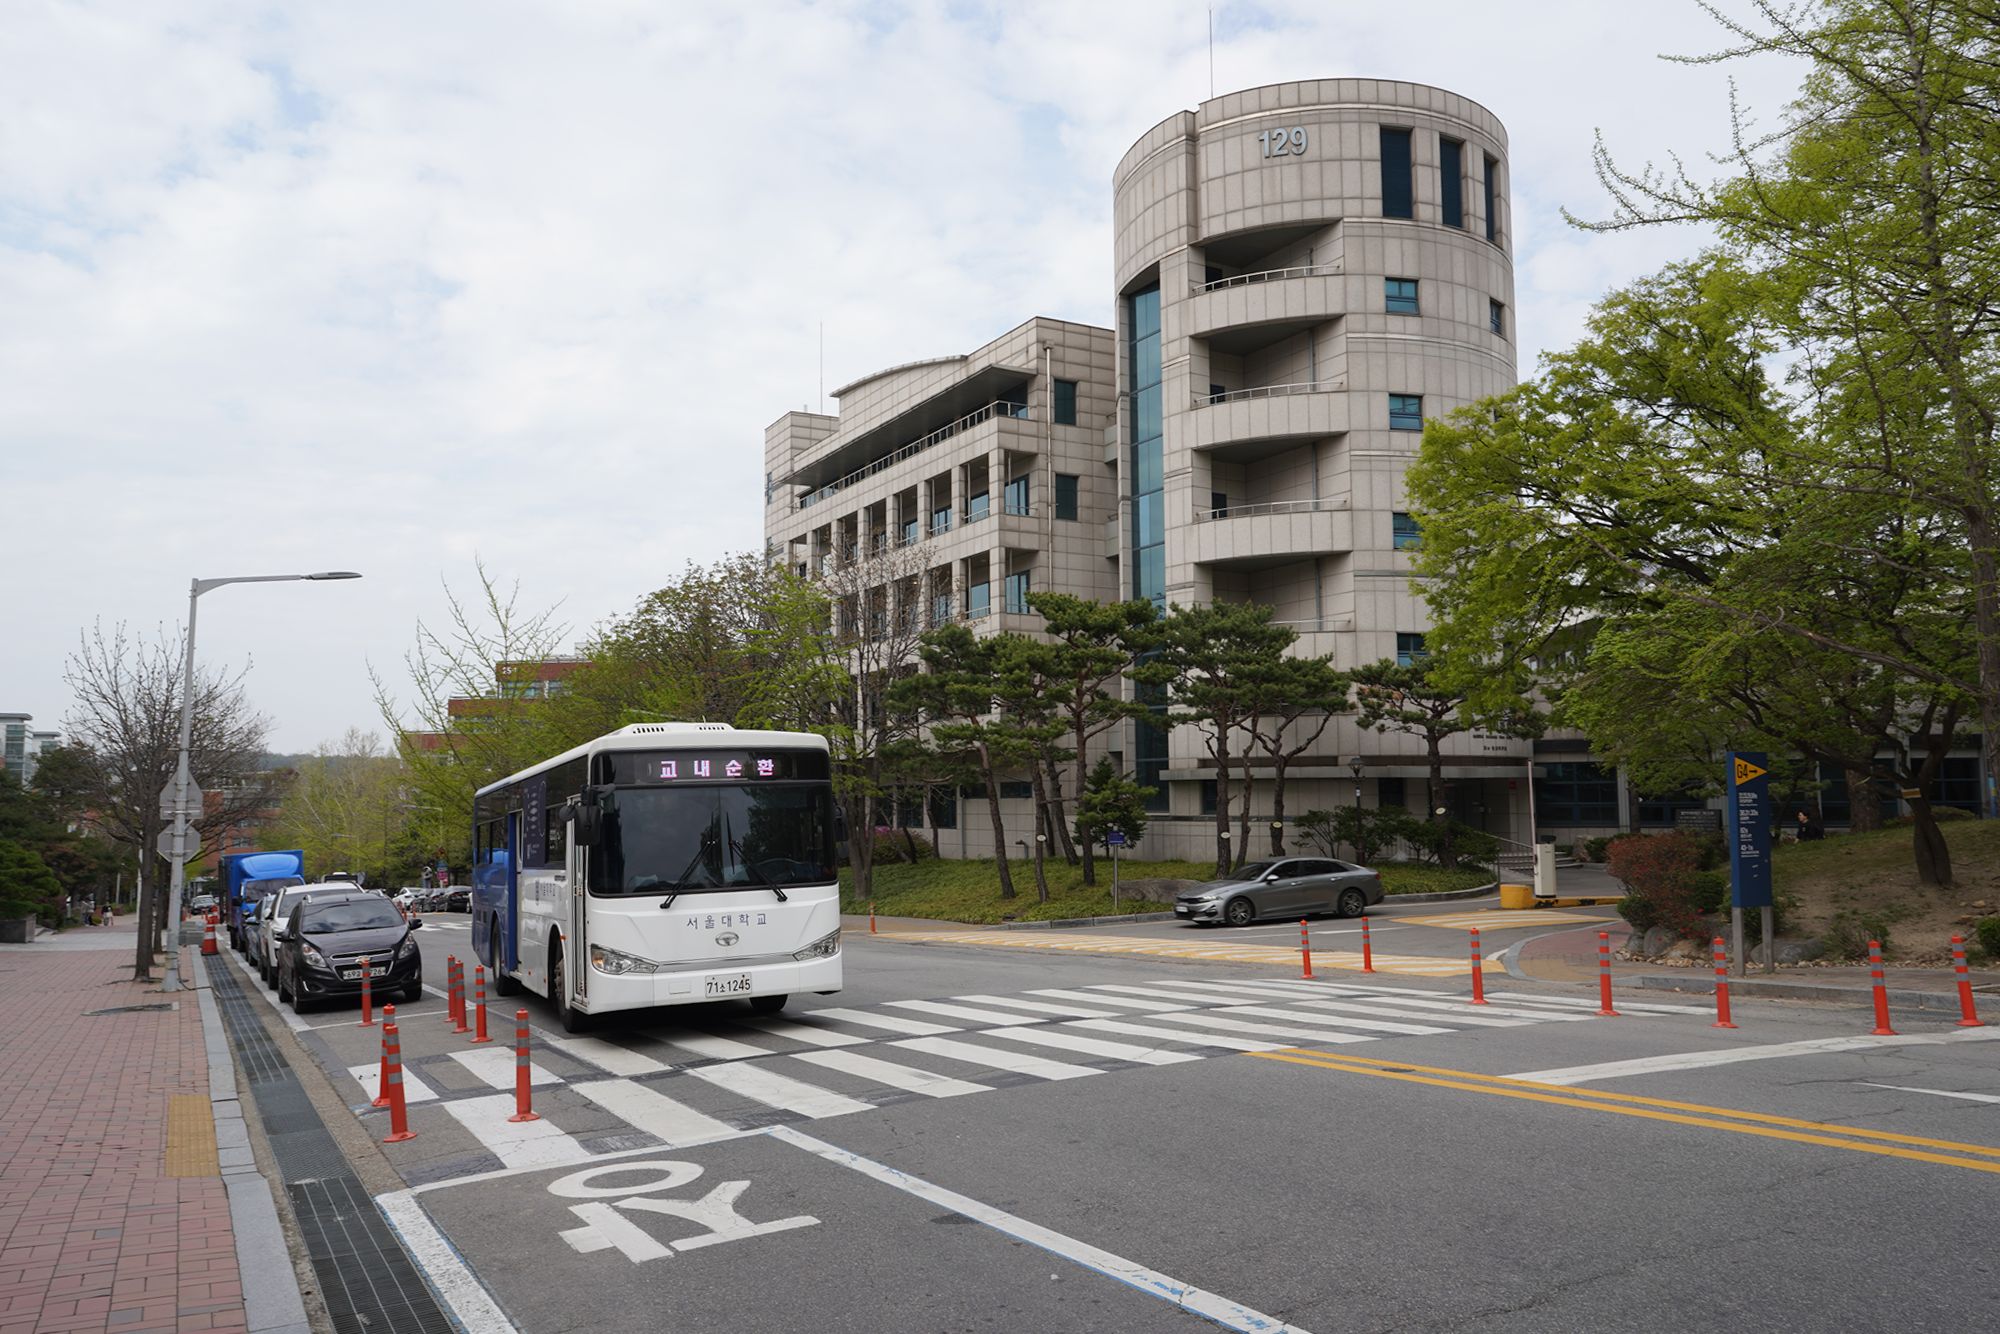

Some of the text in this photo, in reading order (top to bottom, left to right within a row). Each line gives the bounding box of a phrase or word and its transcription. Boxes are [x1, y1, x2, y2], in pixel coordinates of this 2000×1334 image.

[1258, 126, 1308, 159] 129
[1737, 763, 1748, 779] G4
[687, 913, 767, 930] 서울대학교
